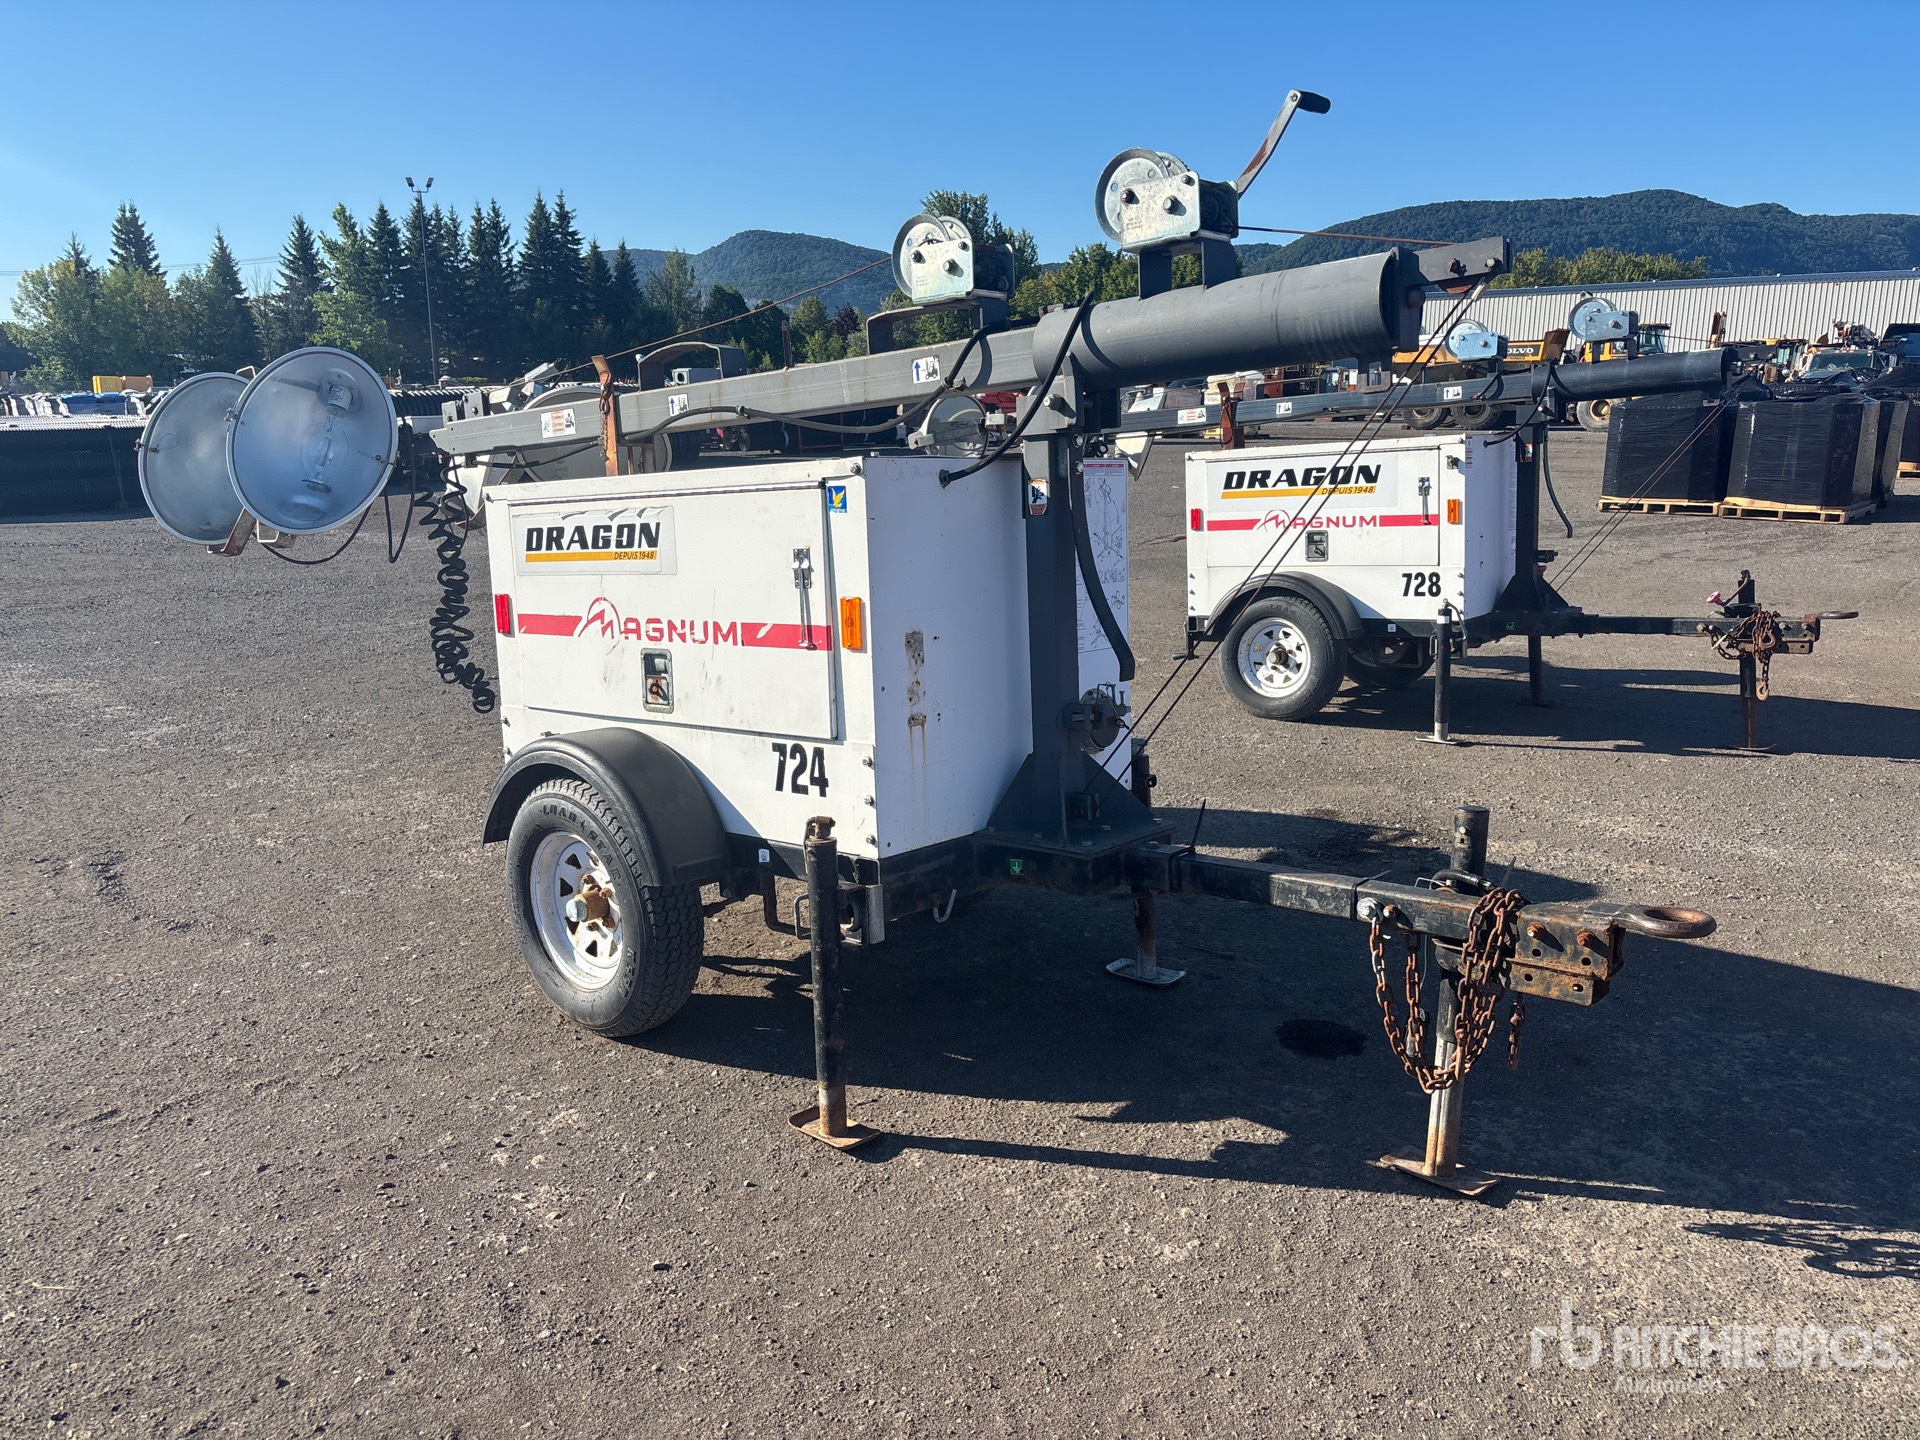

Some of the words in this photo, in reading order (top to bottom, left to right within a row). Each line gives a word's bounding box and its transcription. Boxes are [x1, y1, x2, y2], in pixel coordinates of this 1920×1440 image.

[1223, 464, 1381, 490] DRAGON
[1354, 486, 1374, 494] 1948
[1257, 509, 1377, 533] MAGNUM
[525, 521, 661, 552] DRAGON
[613, 551, 638, 560] DEPUIS
[638, 551, 655, 560] 1948
[1402, 572, 1441, 597] 728
[578, 597, 738, 647] MAGNUM
[772, 743, 829, 797] 724
